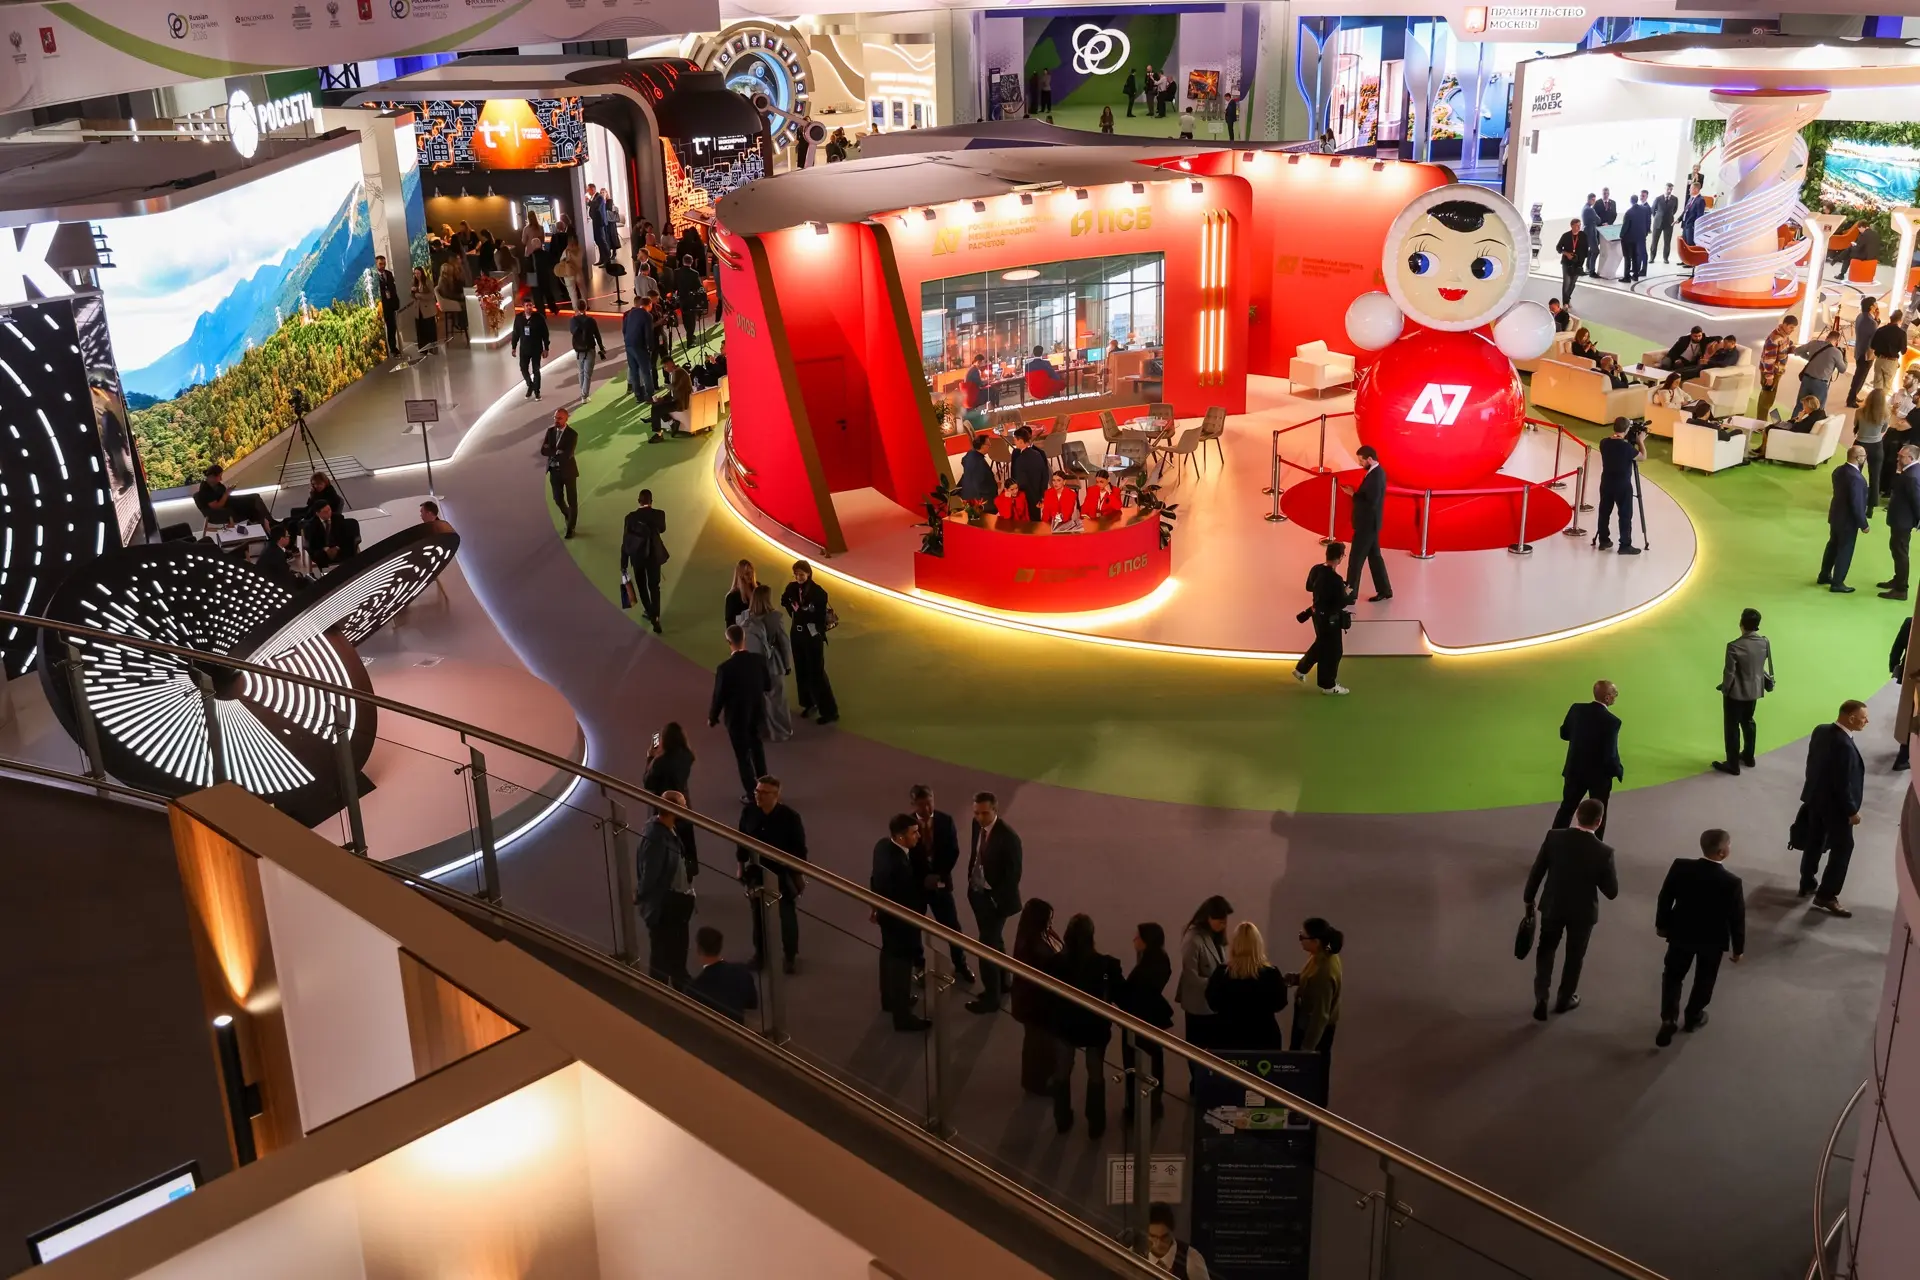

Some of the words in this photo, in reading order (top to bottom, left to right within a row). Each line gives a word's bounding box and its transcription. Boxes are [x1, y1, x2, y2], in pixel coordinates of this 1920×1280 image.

[188, 13, 209, 21] Russian
[1490, 7, 1585, 18] ПРАВИТЕЛЬСТВО
[1489, 20, 1539, 30] МОСКВЫ
[1534, 92, 1562, 104] ИНТЕР
[256, 91, 315, 134] РОССЕТИ
[1531, 102, 1547, 113] РАО
[1547, 99, 1563, 110] ЕЭС
[1097, 205, 1153, 234] ПСБ
[1123, 553, 1149, 573] ПСБ
